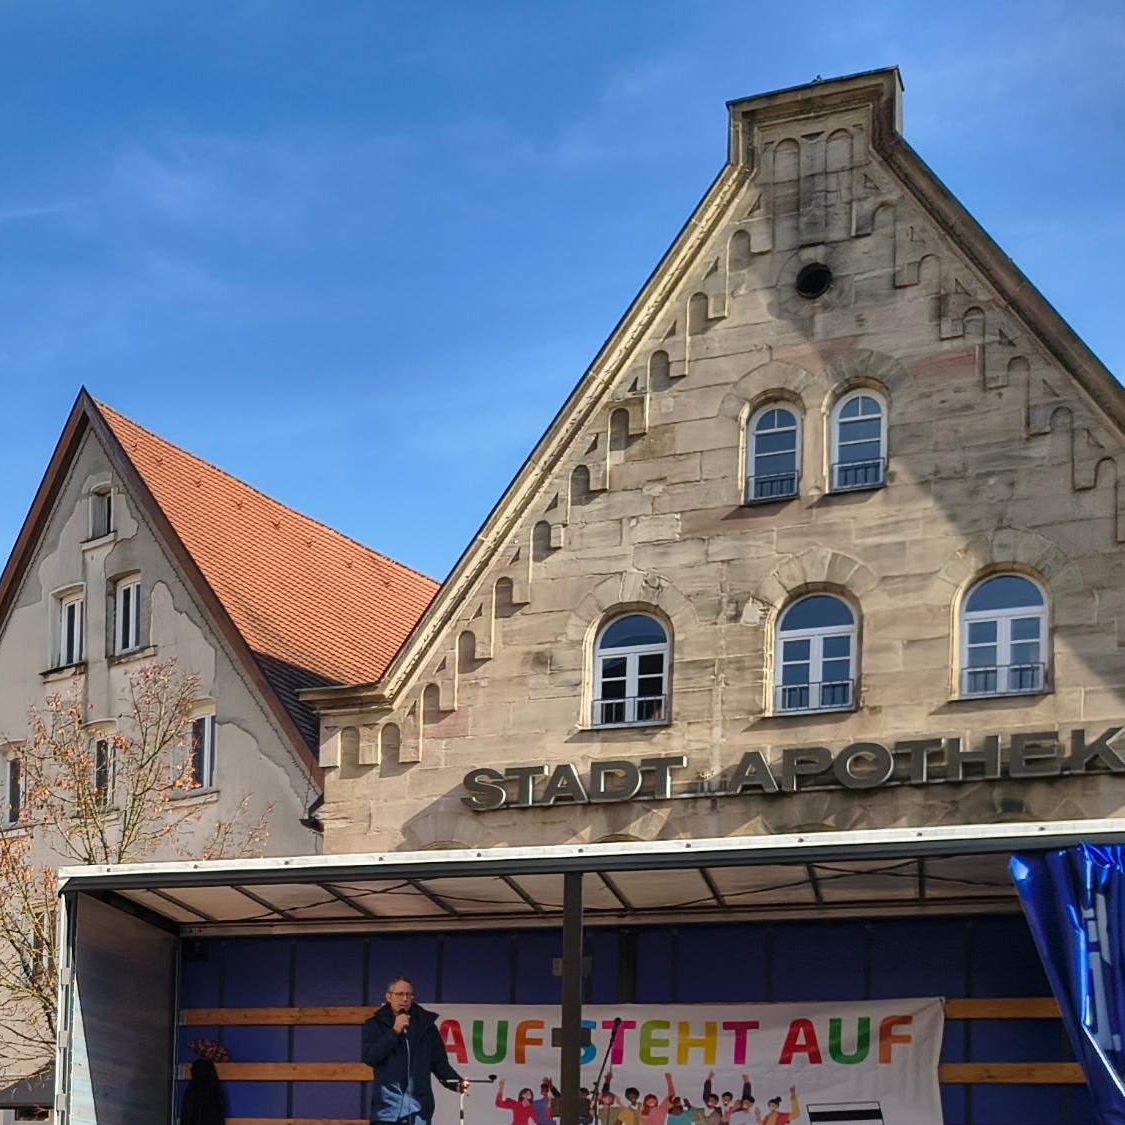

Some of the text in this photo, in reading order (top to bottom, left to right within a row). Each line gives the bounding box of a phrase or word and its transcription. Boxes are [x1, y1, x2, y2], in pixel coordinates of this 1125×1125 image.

[462, 726, 1125, 811] STADT APOTHEK
[779, 1014, 914, 1065] AUF
